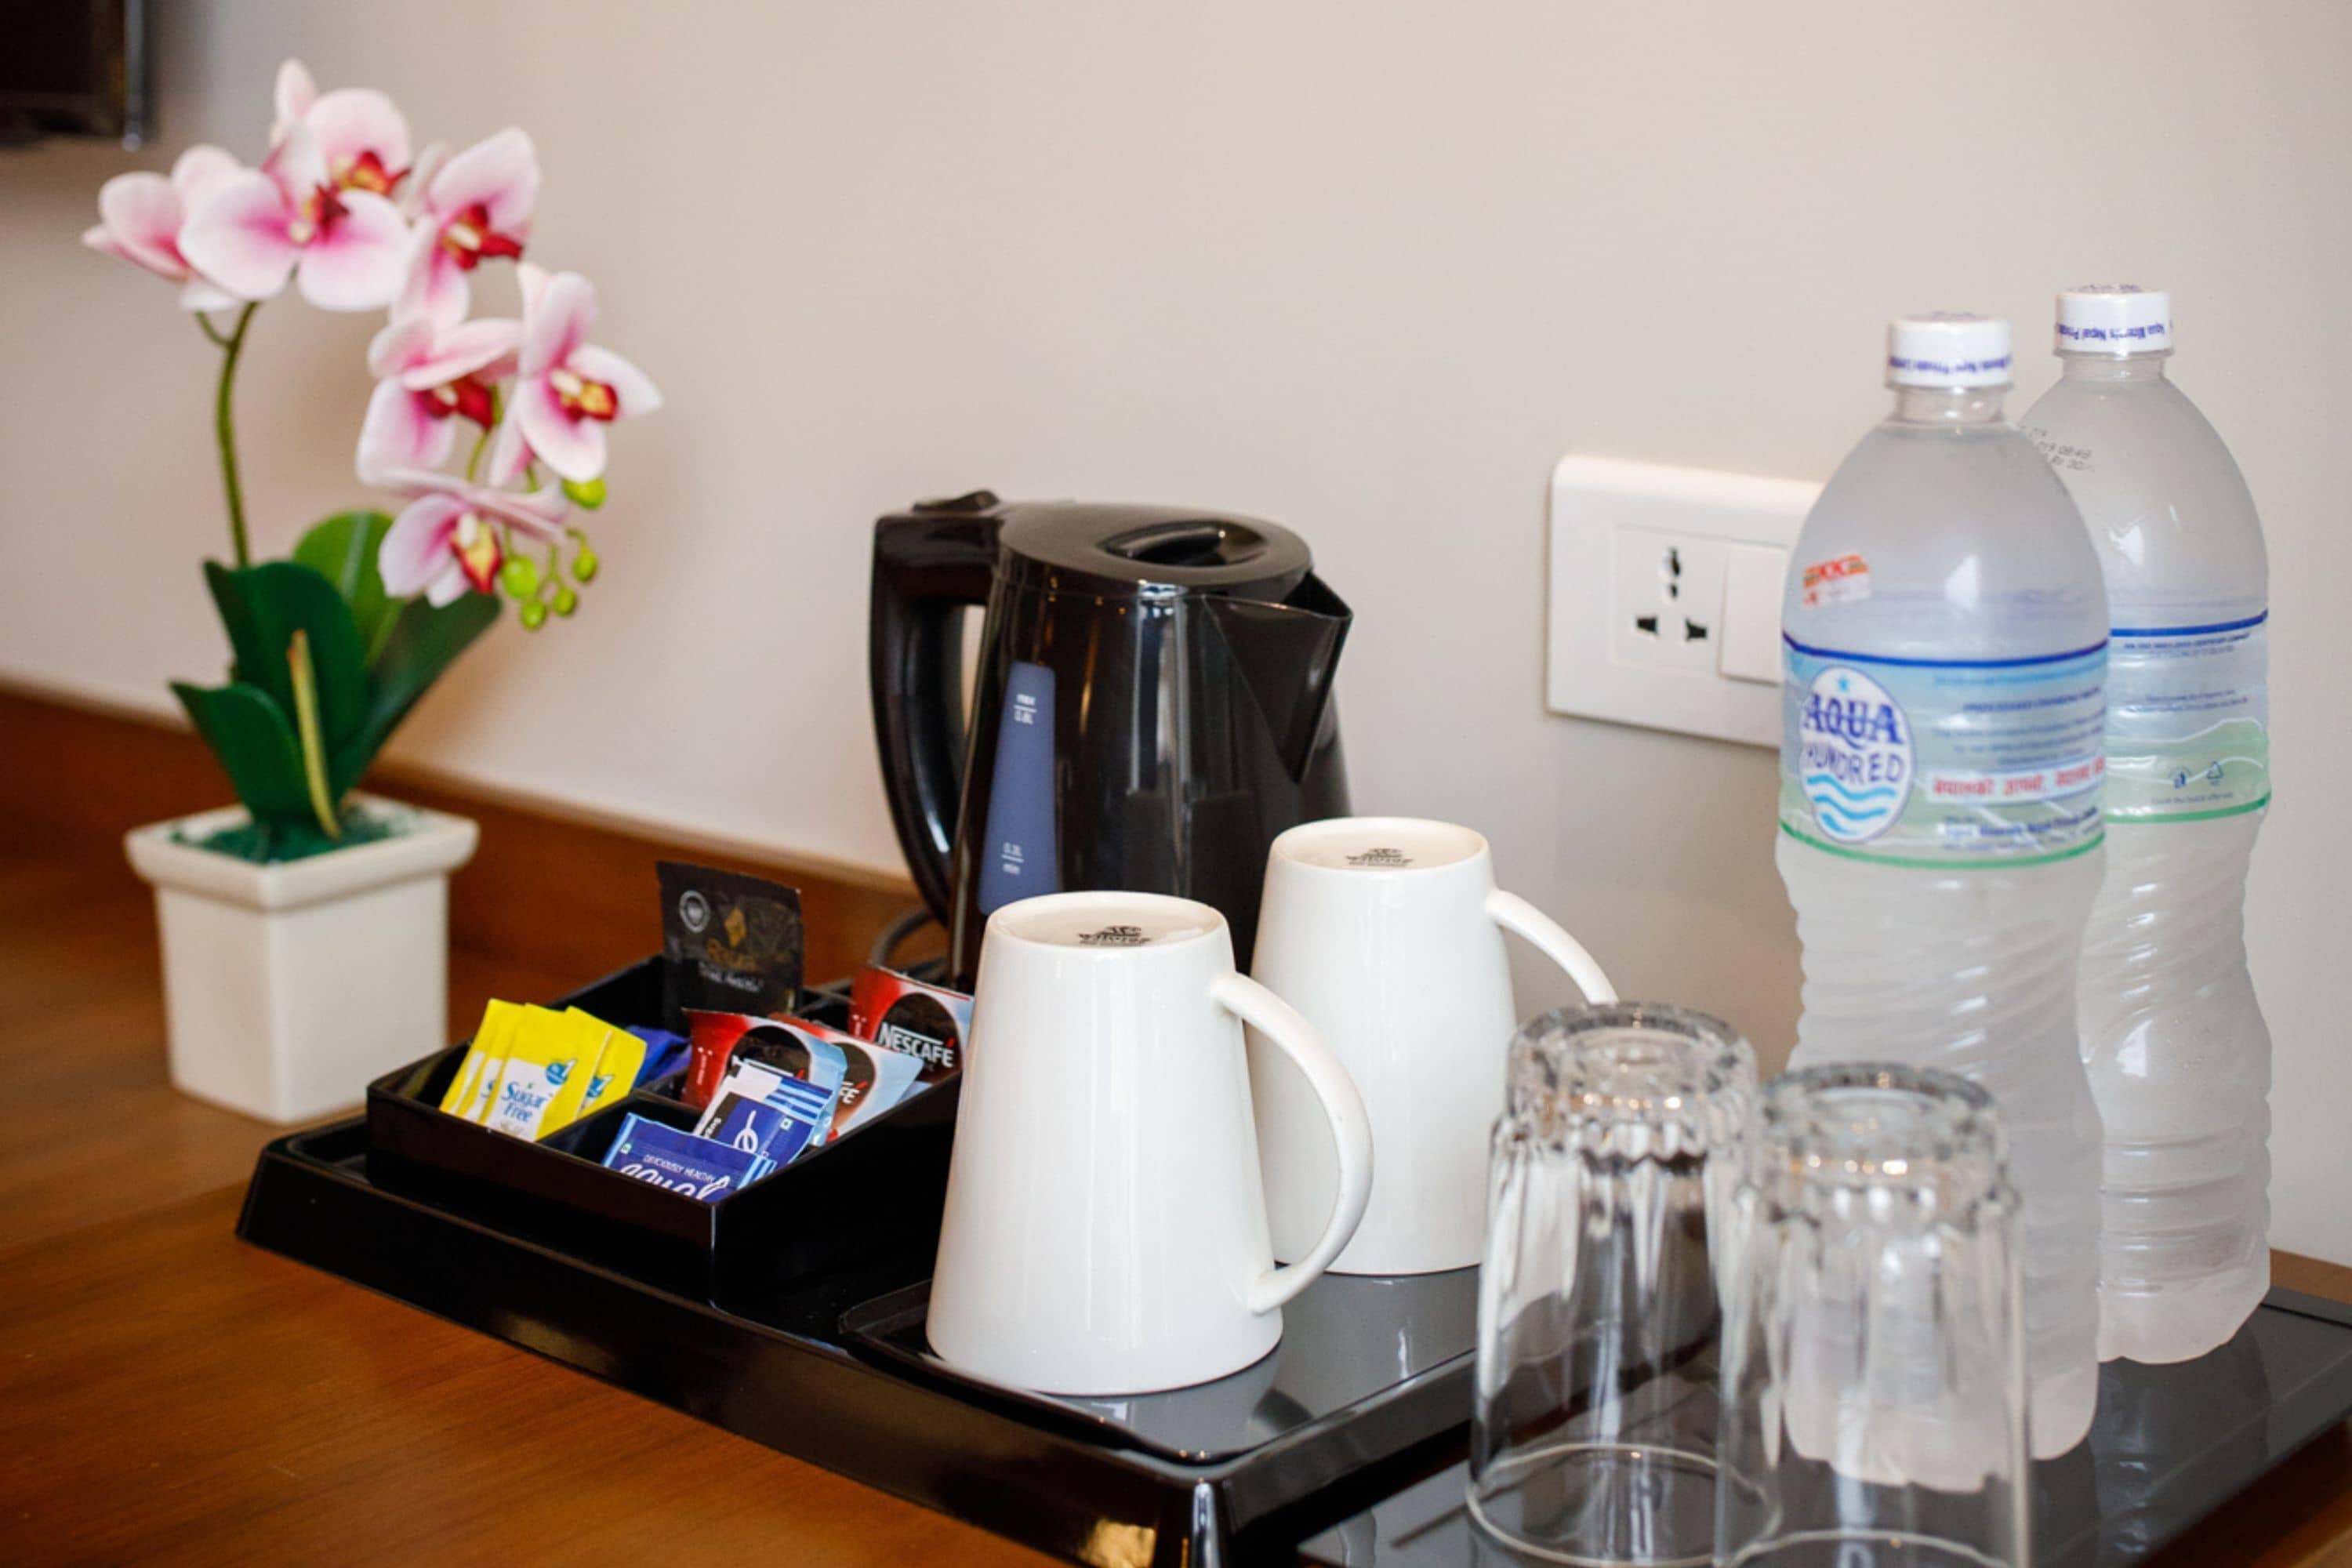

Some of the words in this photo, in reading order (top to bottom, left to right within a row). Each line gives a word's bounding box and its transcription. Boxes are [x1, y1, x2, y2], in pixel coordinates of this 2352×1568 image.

[1804, 692, 1904, 750] AQUA
[877, 1021, 955, 1068] NESCAFÉ
[501, 1080, 547, 1109] Sugar
[503, 1099, 533, 1123] Free
